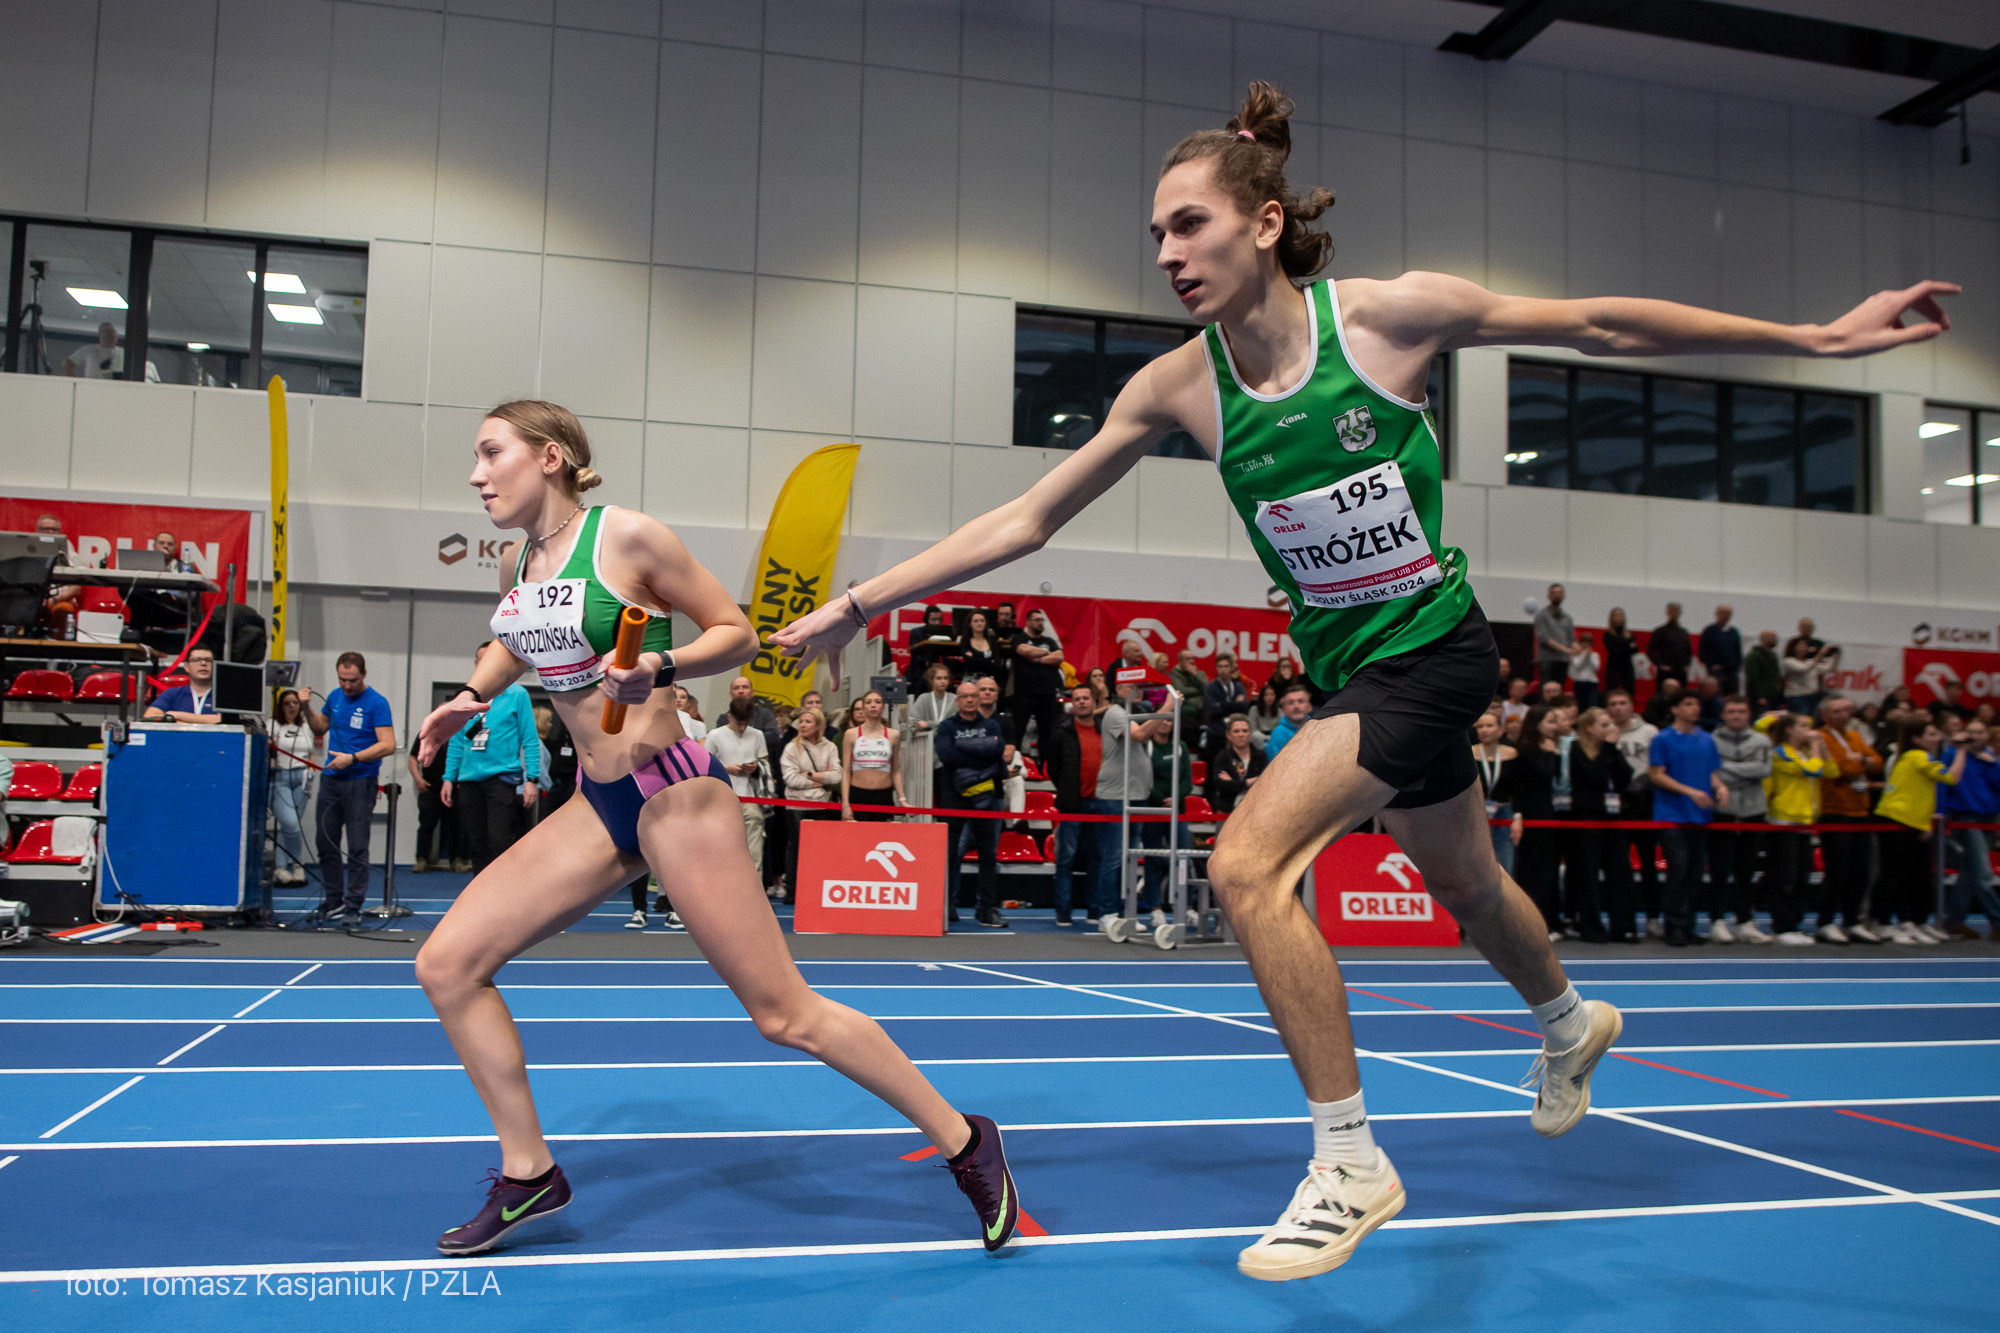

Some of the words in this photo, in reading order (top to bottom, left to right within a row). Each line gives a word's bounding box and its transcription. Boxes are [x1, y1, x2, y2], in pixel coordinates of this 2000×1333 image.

[1329, 472, 1388, 515] 195
[1273, 522, 1306, 534] ORLEN
[1280, 514, 1419, 571] STRÓŻEK
[1332, 578, 1374, 591] Mistrzostwa
[1374, 572, 1396, 583] Polski
[1397, 568, 1411, 577] U18
[1416, 558, 1431, 569] U20
[537, 585, 573, 608] 192
[1312, 594, 1346, 605] DOLNY
[1348, 586, 1390, 602] ŚLĄSK
[1390, 576, 1426, 594] 2024
[750, 556, 791, 675] DOLNY
[566, 671, 593, 685] 2024
[1823, 664, 1883, 691] anik
[828, 884, 911, 905] ORLEN
[1347, 897, 1426, 915] ORLEN
